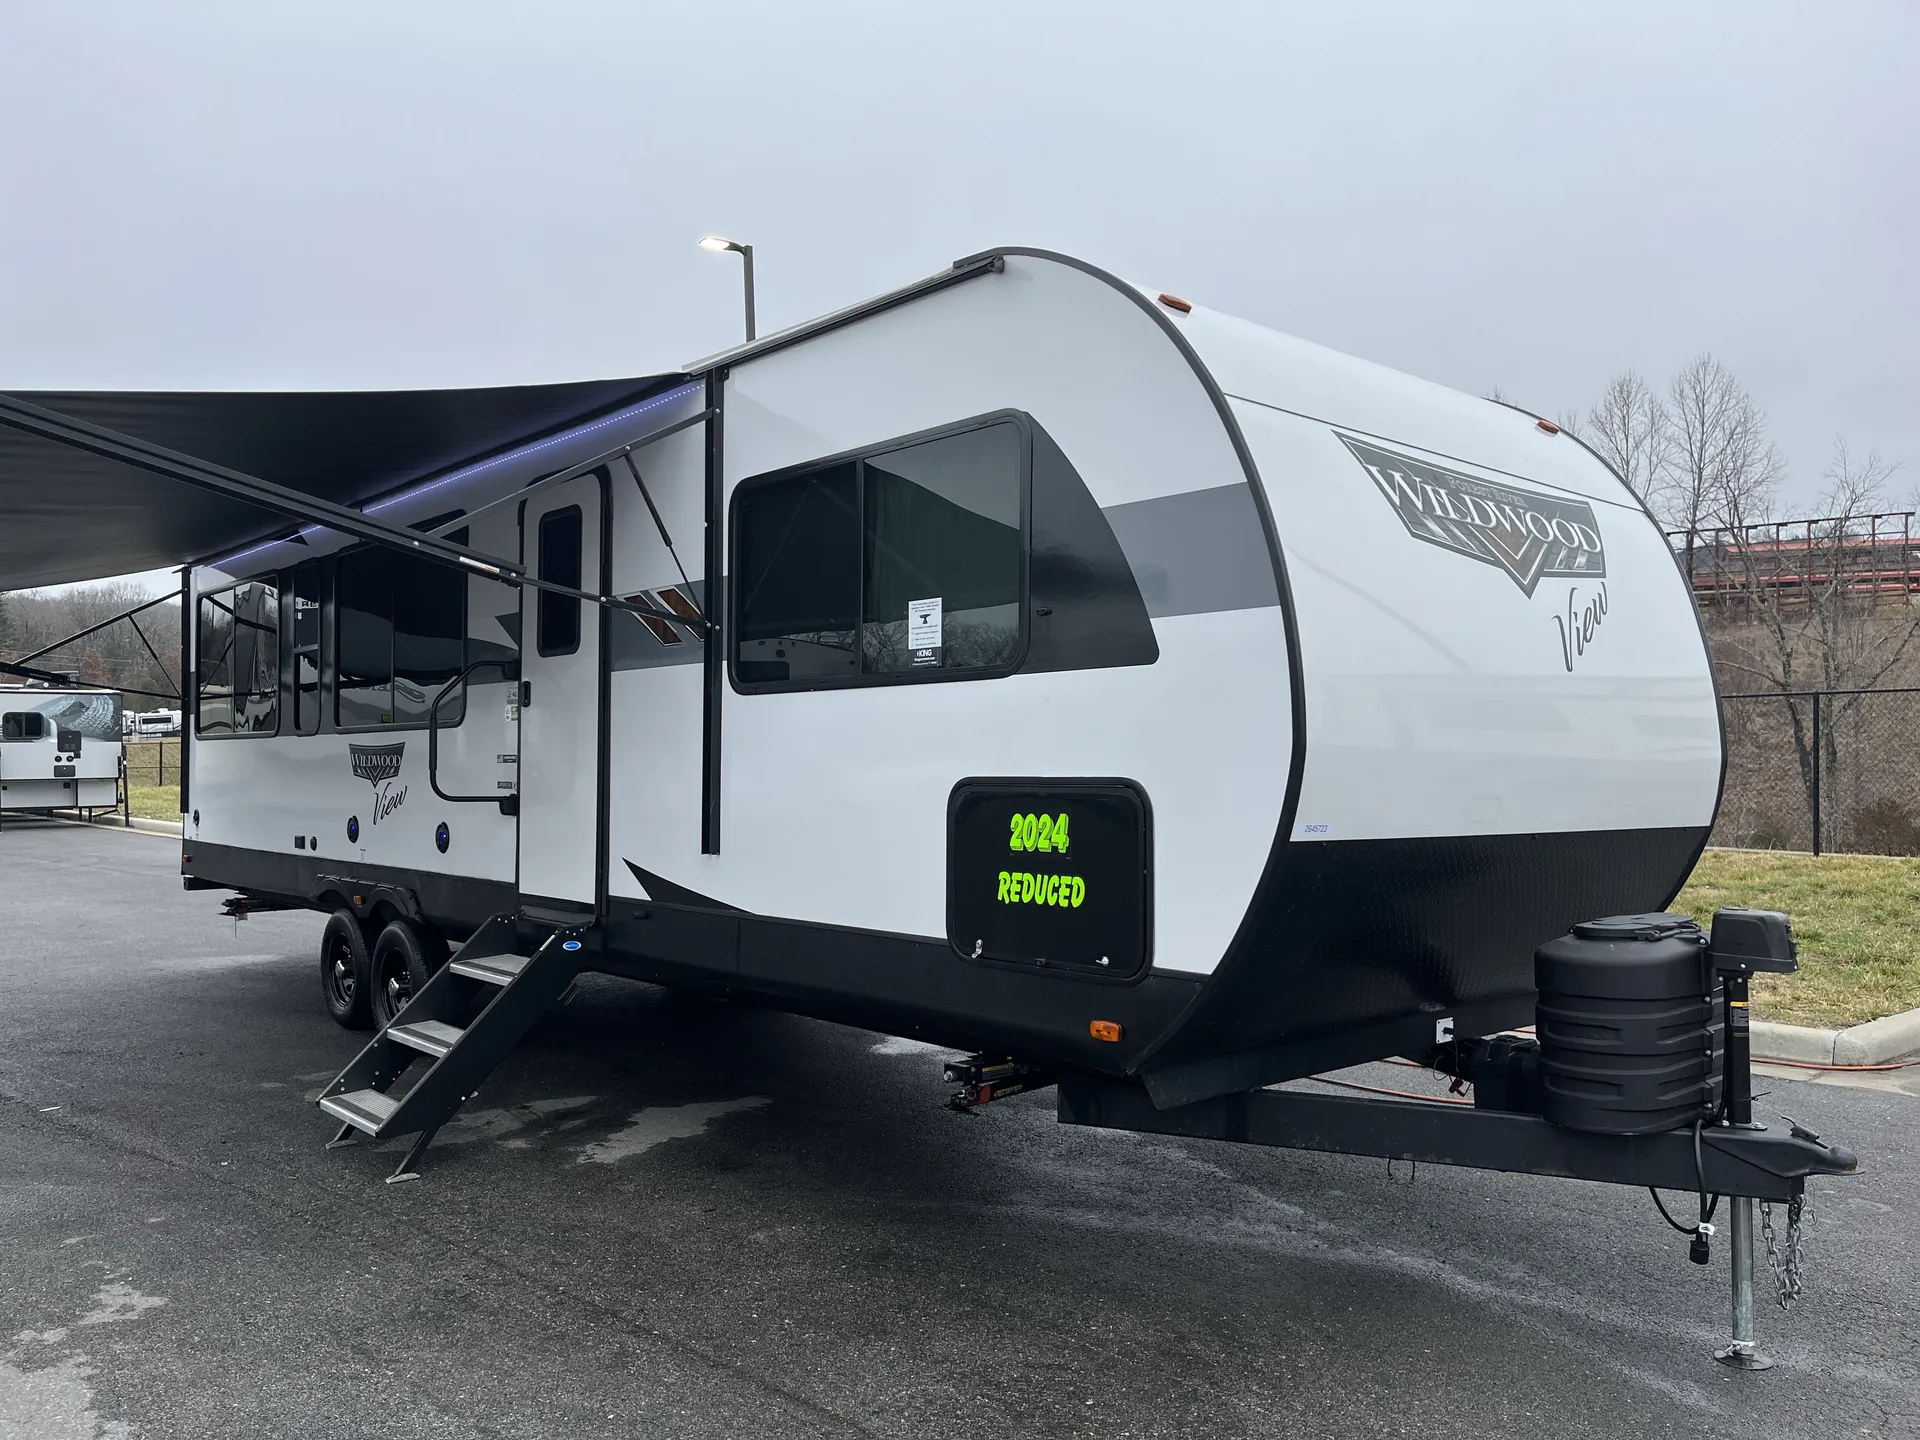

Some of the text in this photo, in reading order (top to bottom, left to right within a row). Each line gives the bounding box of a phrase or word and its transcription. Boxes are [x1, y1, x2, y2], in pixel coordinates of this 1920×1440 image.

[1361, 463, 1601, 553] WILDWOOD
[1551, 581, 1608, 673] View
[351, 753, 401, 767] WILDWOOD
[372, 781, 408, 826] View
[1010, 813, 1070, 854] 2024
[997, 871, 1086, 908] REDUCED
